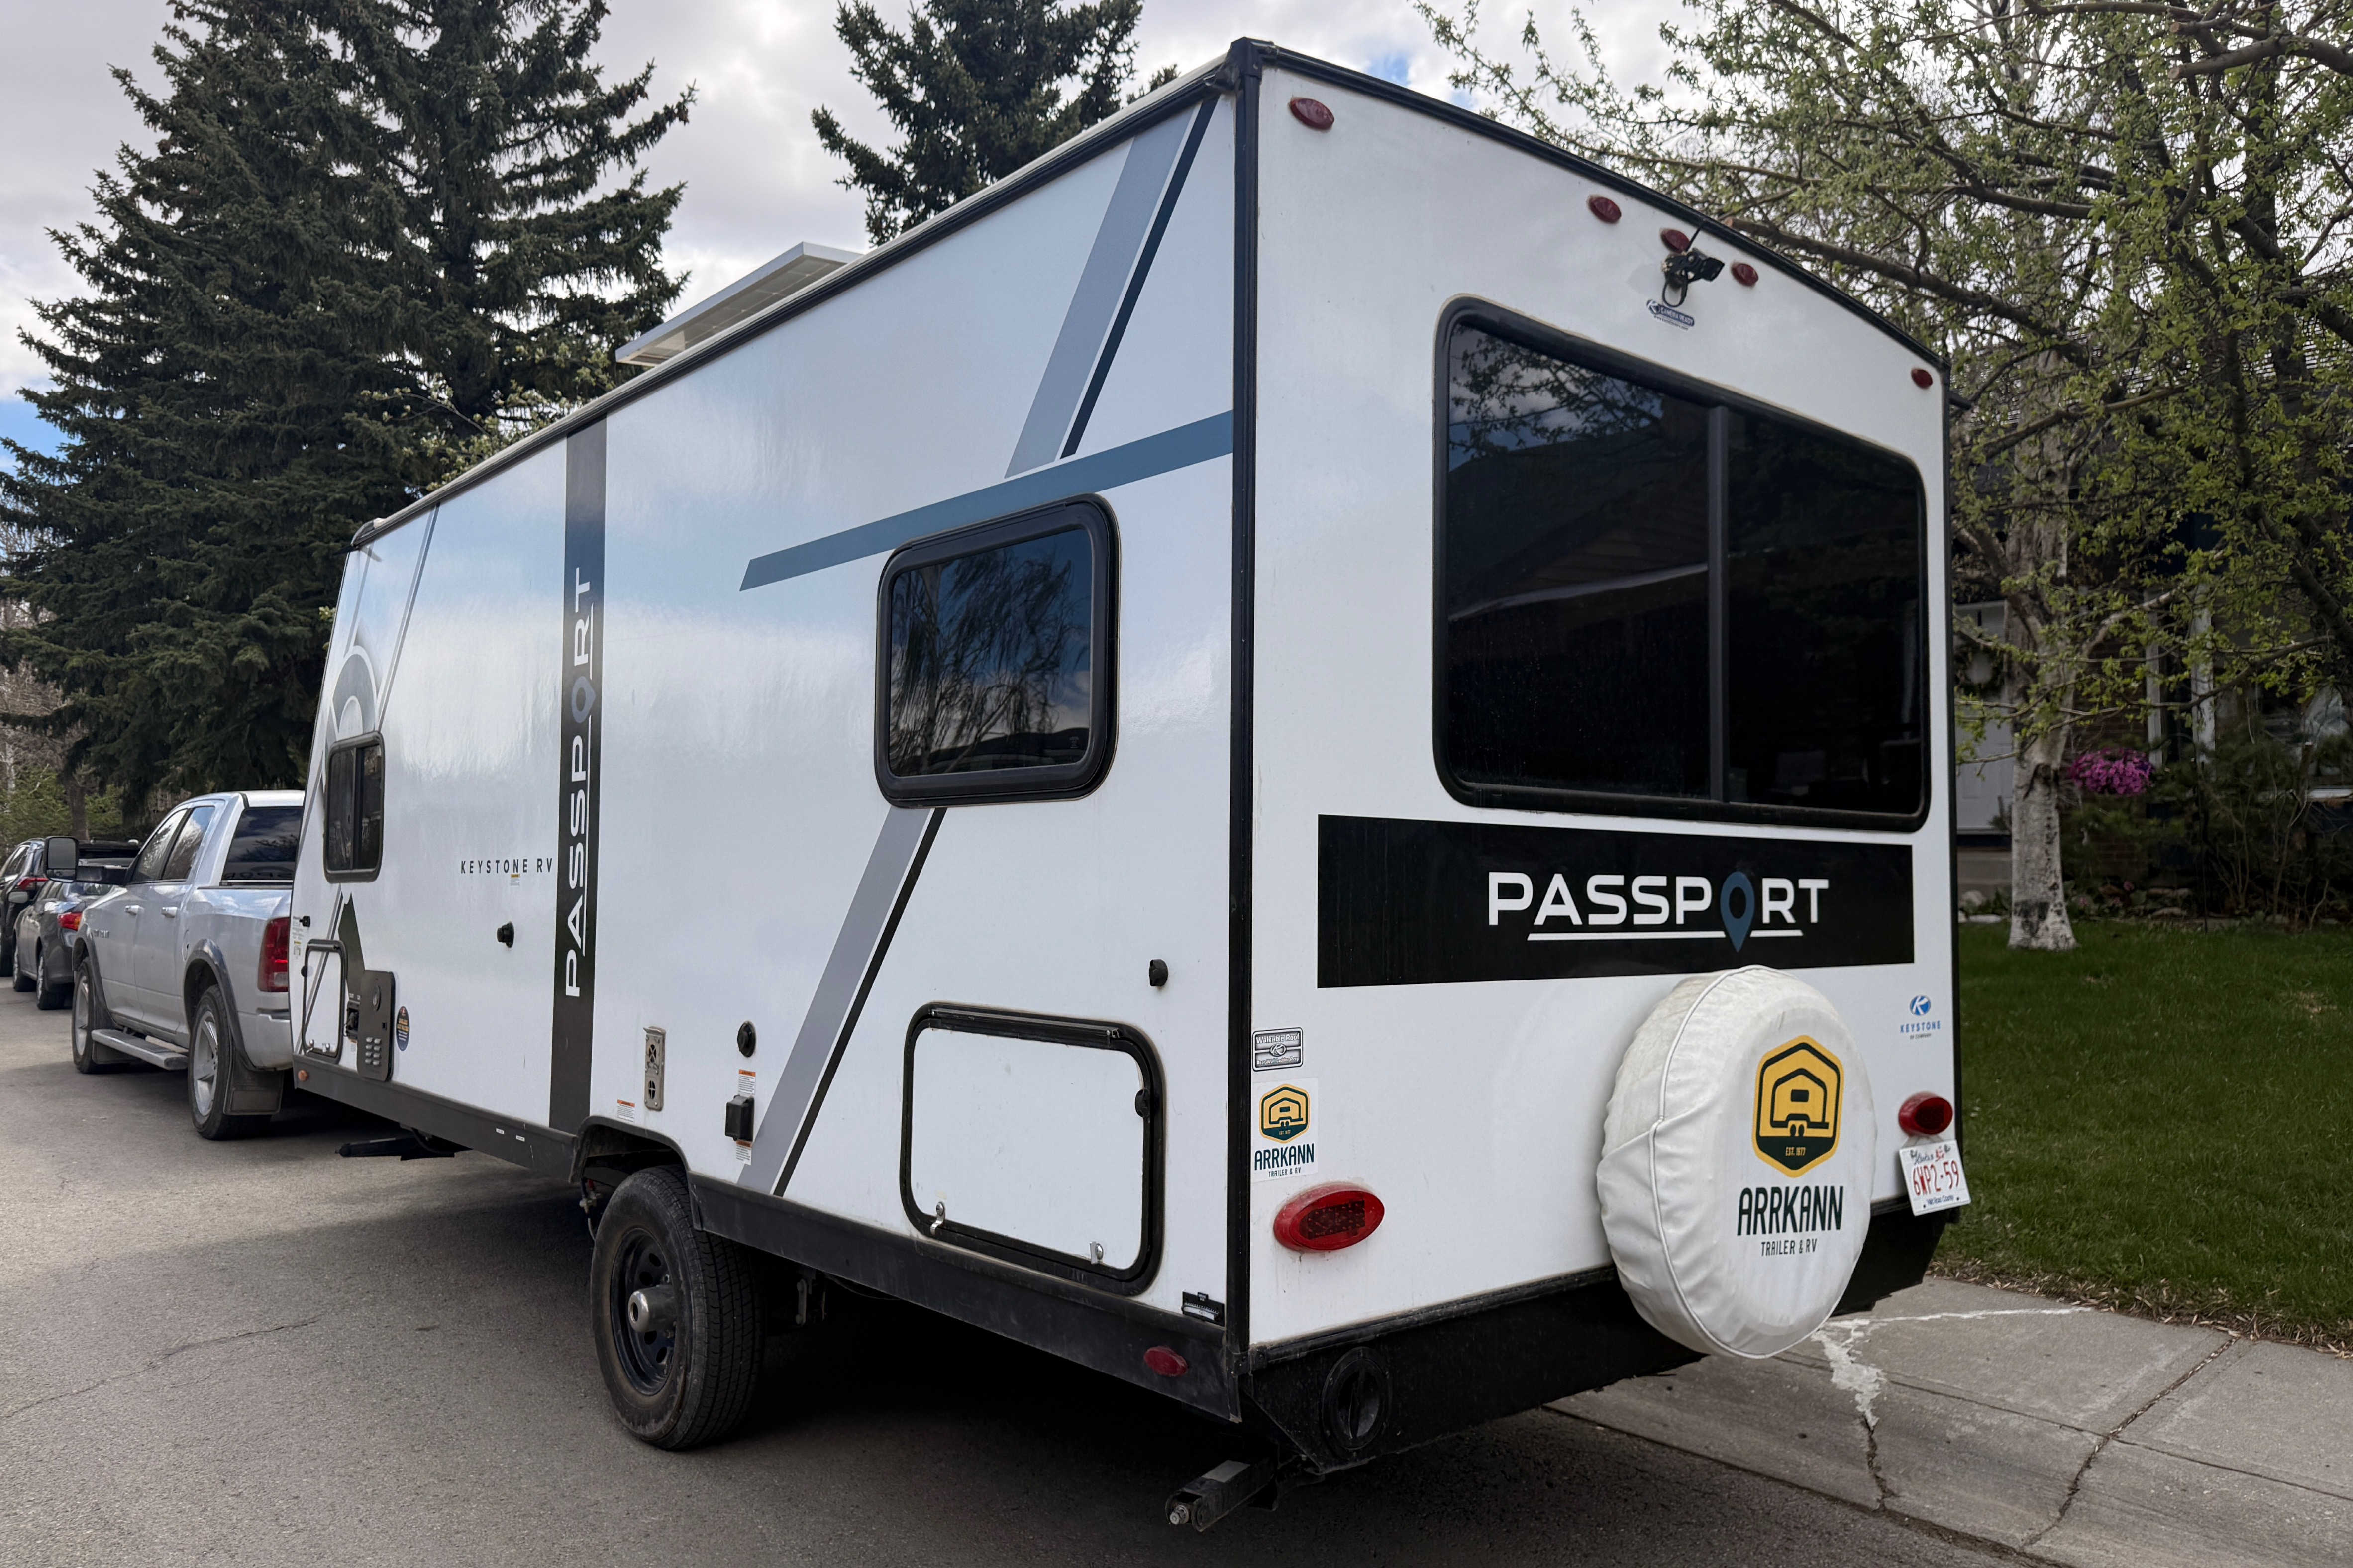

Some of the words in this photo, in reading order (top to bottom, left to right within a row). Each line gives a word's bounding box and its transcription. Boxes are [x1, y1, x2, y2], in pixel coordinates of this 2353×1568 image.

[566, 567, 596, 997] PASSPORT
[461, 859, 528, 874] KEYSTONE
[537, 858, 552, 873] RV
[1488, 871, 1829, 952] PASSPORT
[1900, 1020, 1941, 1033] KEYSTONE
[1256, 1035, 1284, 1044] Walkable
[1254, 1143, 1314, 1171] ARRKANN
[1785, 1147, 1795, 1156] EST.
[1268, 1169, 1288, 1177] TRAILER
[1737, 1185, 1843, 1236] ARRKANN
[1761, 1240, 1795, 1257] TRAILER
[1799, 1240, 1803, 1254] &
[1805, 1238, 1818, 1253] RV
